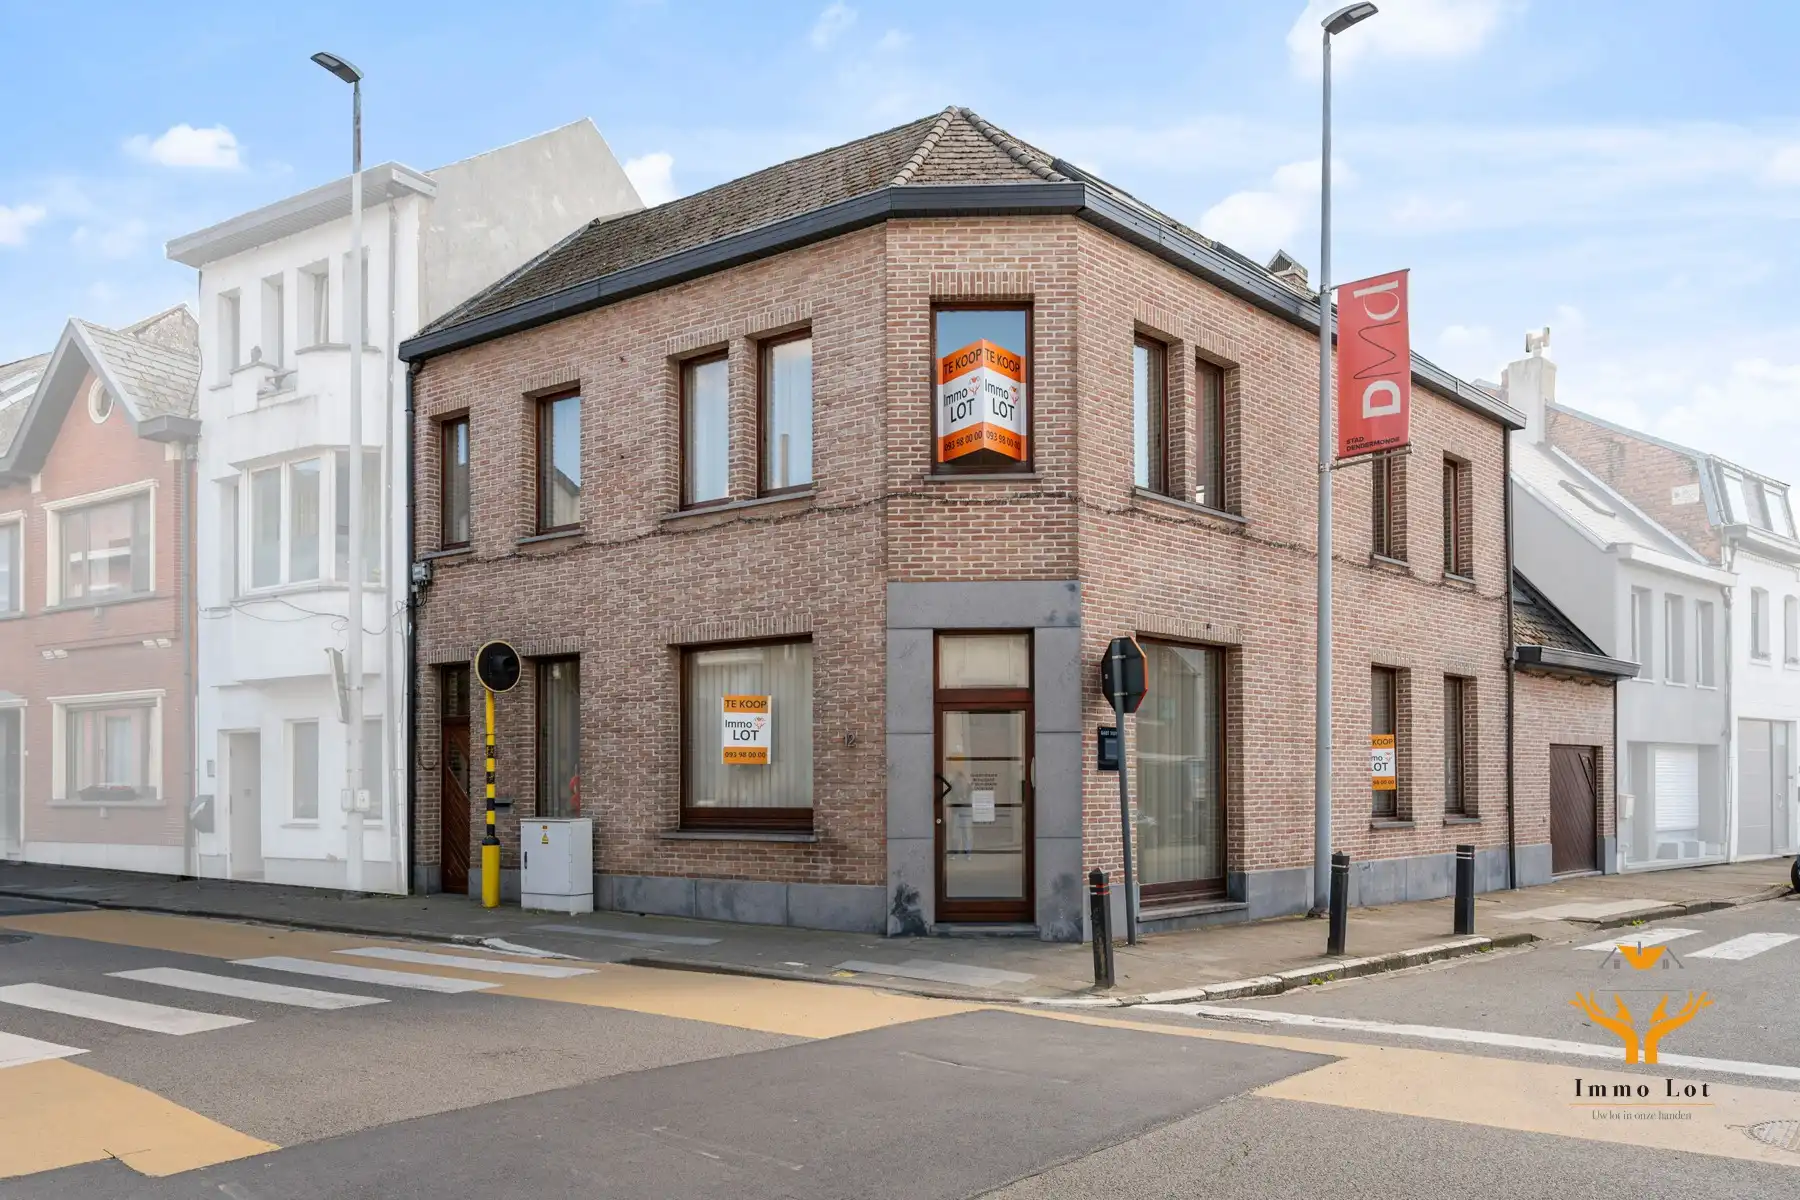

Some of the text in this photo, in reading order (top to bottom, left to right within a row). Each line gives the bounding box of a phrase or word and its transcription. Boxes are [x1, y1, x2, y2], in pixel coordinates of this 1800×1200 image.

[943, 348, 982, 374] TE KOOP
[985, 348, 1020, 373] TE KOOP
[943, 388, 968, 407] Immo
[985, 378, 1009, 400] Immo
[950, 398, 975, 423] LOT
[993, 398, 1015, 421] LOT
[965, 434, 973, 444] 00
[974, 430, 983, 440] 00
[986, 430, 998, 441] 093
[998, 434, 1006, 444] 98
[1006, 437, 1014, 448] 00
[1346, 436, 1365, 445] STAD
[725, 699, 767, 709] TE KOOP
[725, 719, 753, 728] Immo
[733, 730, 760, 741] LOT
[1371, 762, 1388, 771] OT
